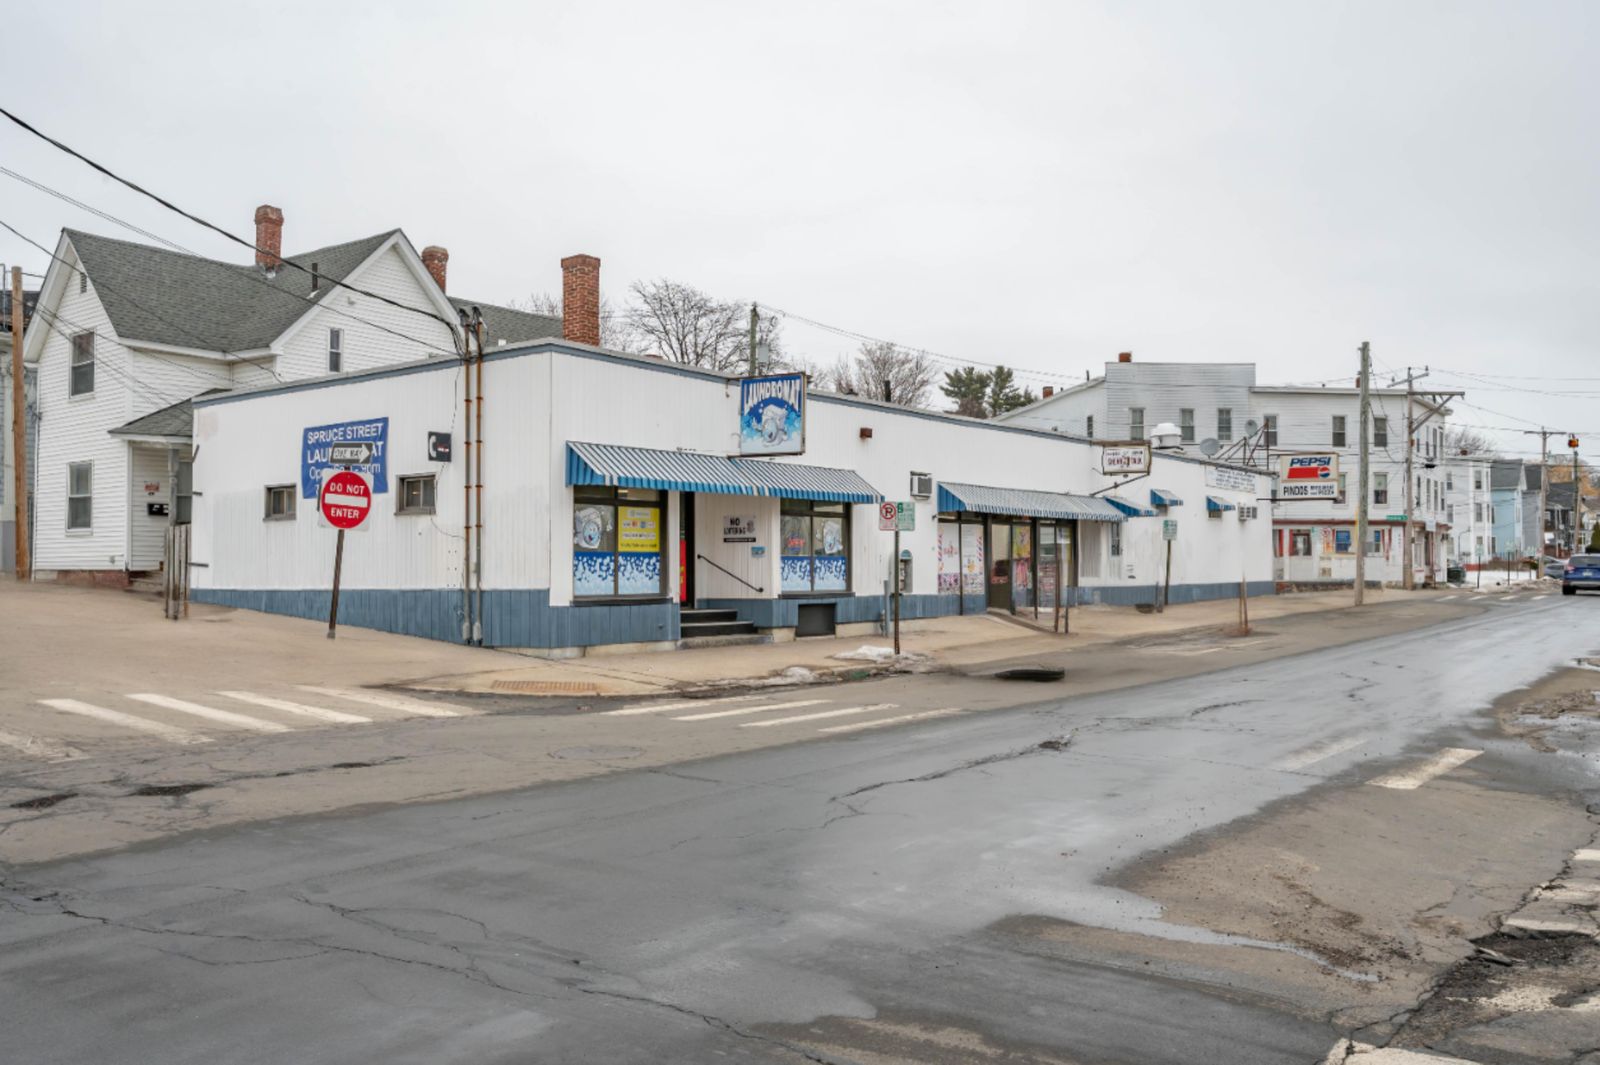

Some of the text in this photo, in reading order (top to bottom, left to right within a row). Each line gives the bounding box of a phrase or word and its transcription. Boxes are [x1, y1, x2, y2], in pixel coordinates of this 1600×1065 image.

[307, 423, 384, 445] SPRUCE STREET
[307, 441, 384, 464] LAUAT
[334, 448, 363, 458] ONE WAY
[1290, 456, 1332, 467] PEPSI
[329, 482, 365, 495] DO NOT
[330, 507, 360, 519] ENTER
[729, 517, 741, 527] NO
